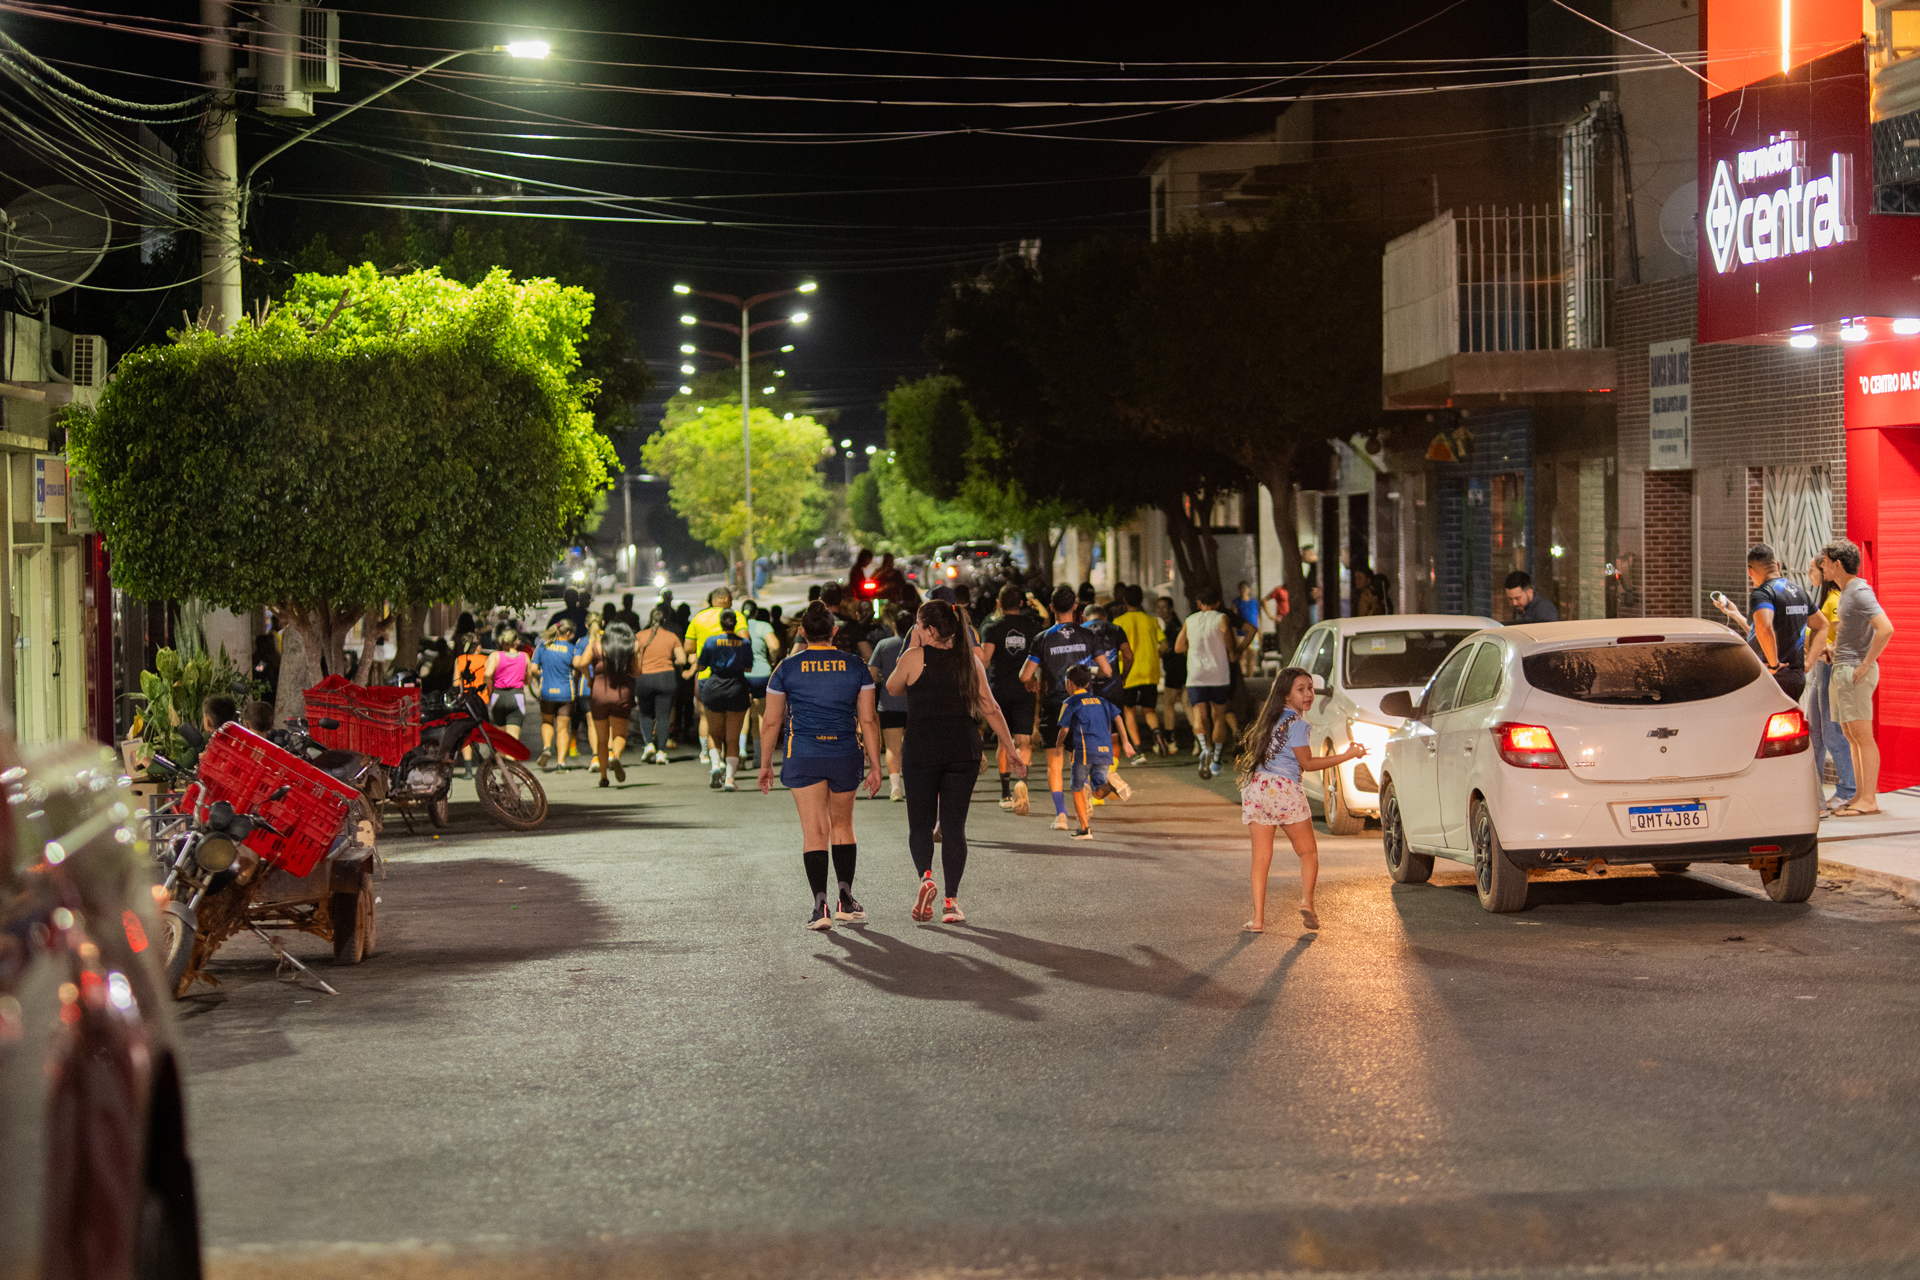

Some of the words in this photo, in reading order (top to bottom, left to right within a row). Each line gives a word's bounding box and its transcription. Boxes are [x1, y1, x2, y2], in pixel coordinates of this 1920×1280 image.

[1737, 151, 1844, 264] central
[1870, 373, 1899, 395] CENTRO
[1900, 372, 1911, 391] DA
[717, 638, 743, 647] ATLETA
[1050, 644, 1086, 655] PATROCINADOR
[801, 660, 846, 672] ATLETA
[1637, 812, 1700, 829] QMT4J86
